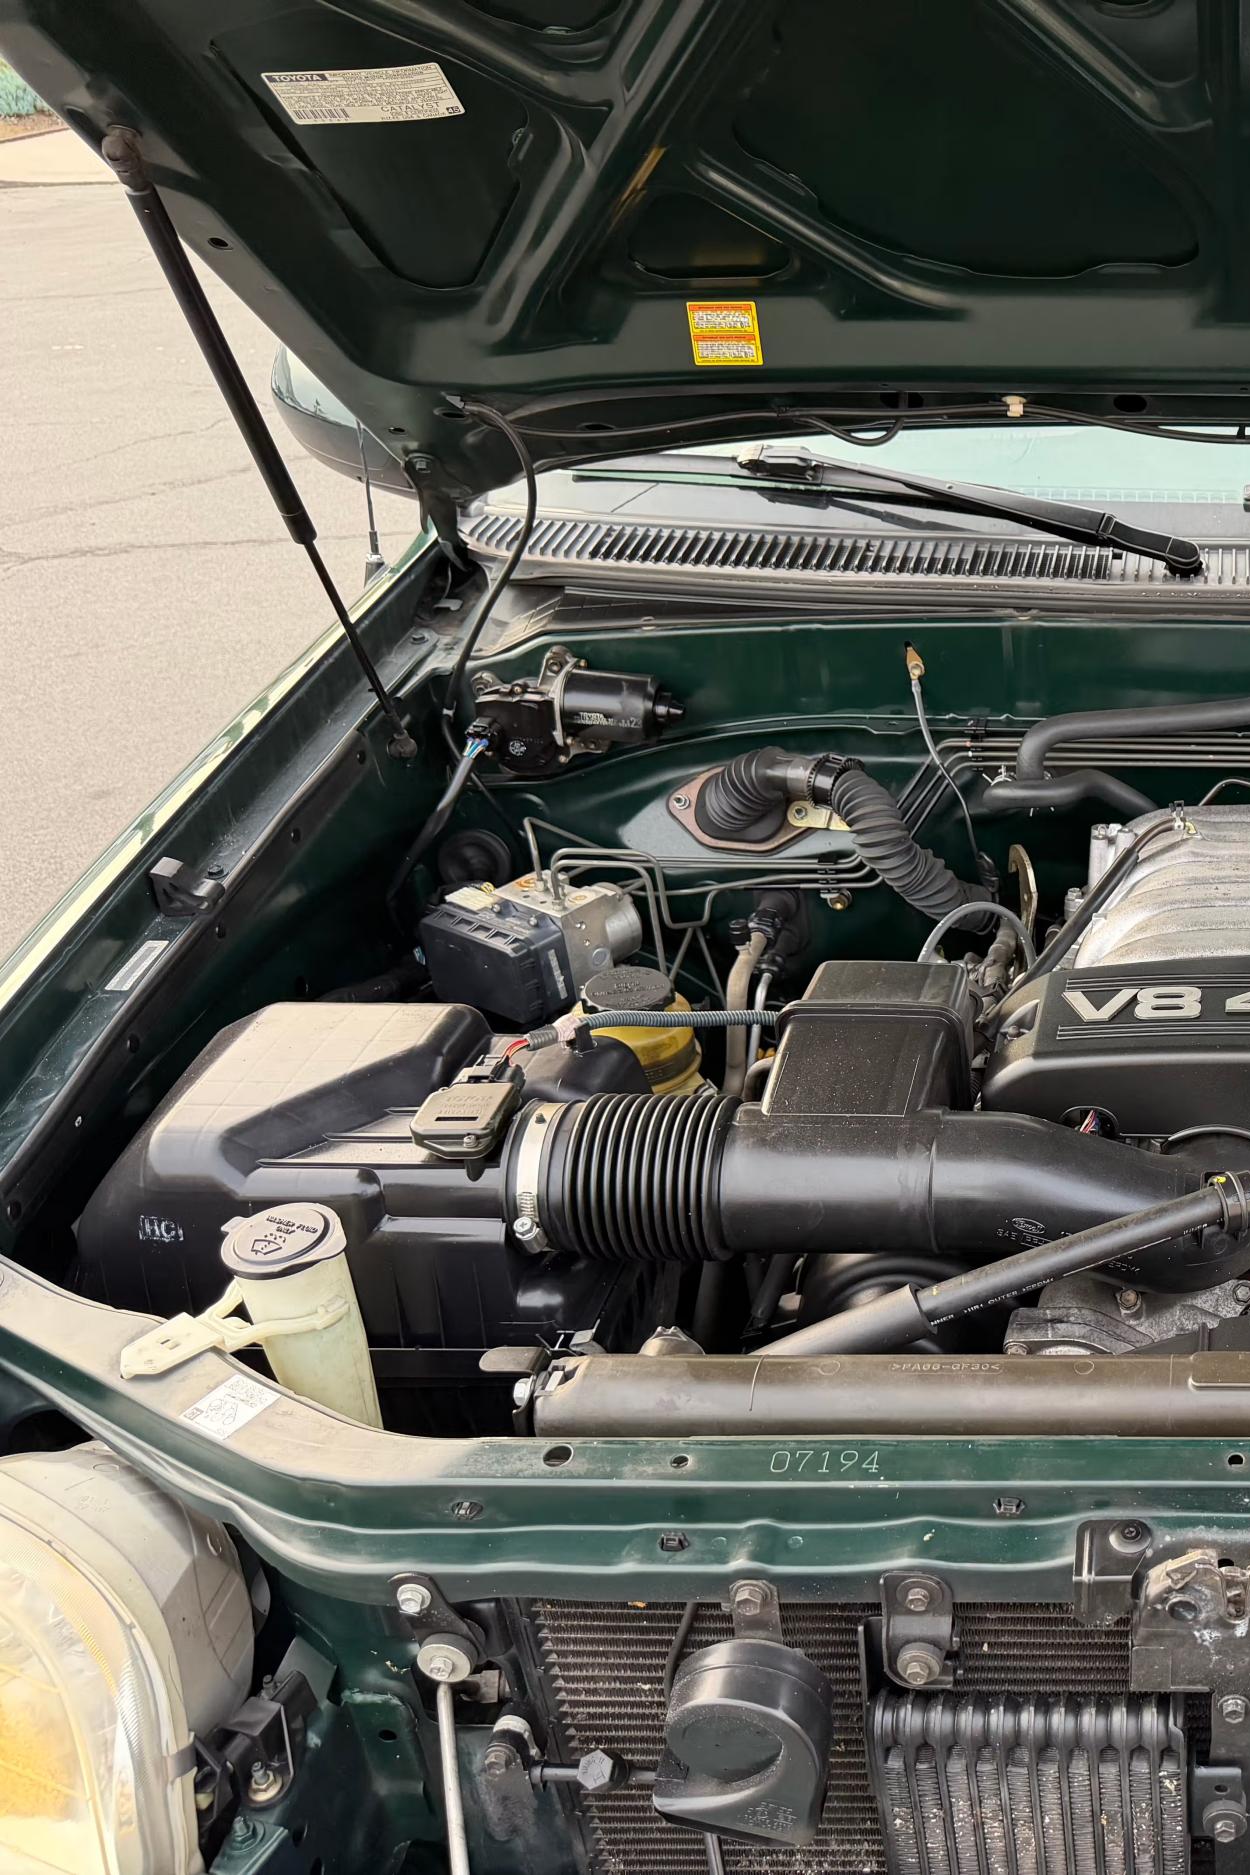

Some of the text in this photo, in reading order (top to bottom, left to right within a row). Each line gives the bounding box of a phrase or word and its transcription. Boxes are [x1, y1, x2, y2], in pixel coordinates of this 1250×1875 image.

[270, 74, 323, 82] TOYOTA
[380, 101, 440, 113] CATALYST
[1061, 986, 1203, 1022] V8
[275, 1225, 296, 1235] ONLY
[296, 1223, 319, 1234] FLUID
[987, 1289, 1018, 1306] OUTER
[769, 1449, 880, 1474] 07194
